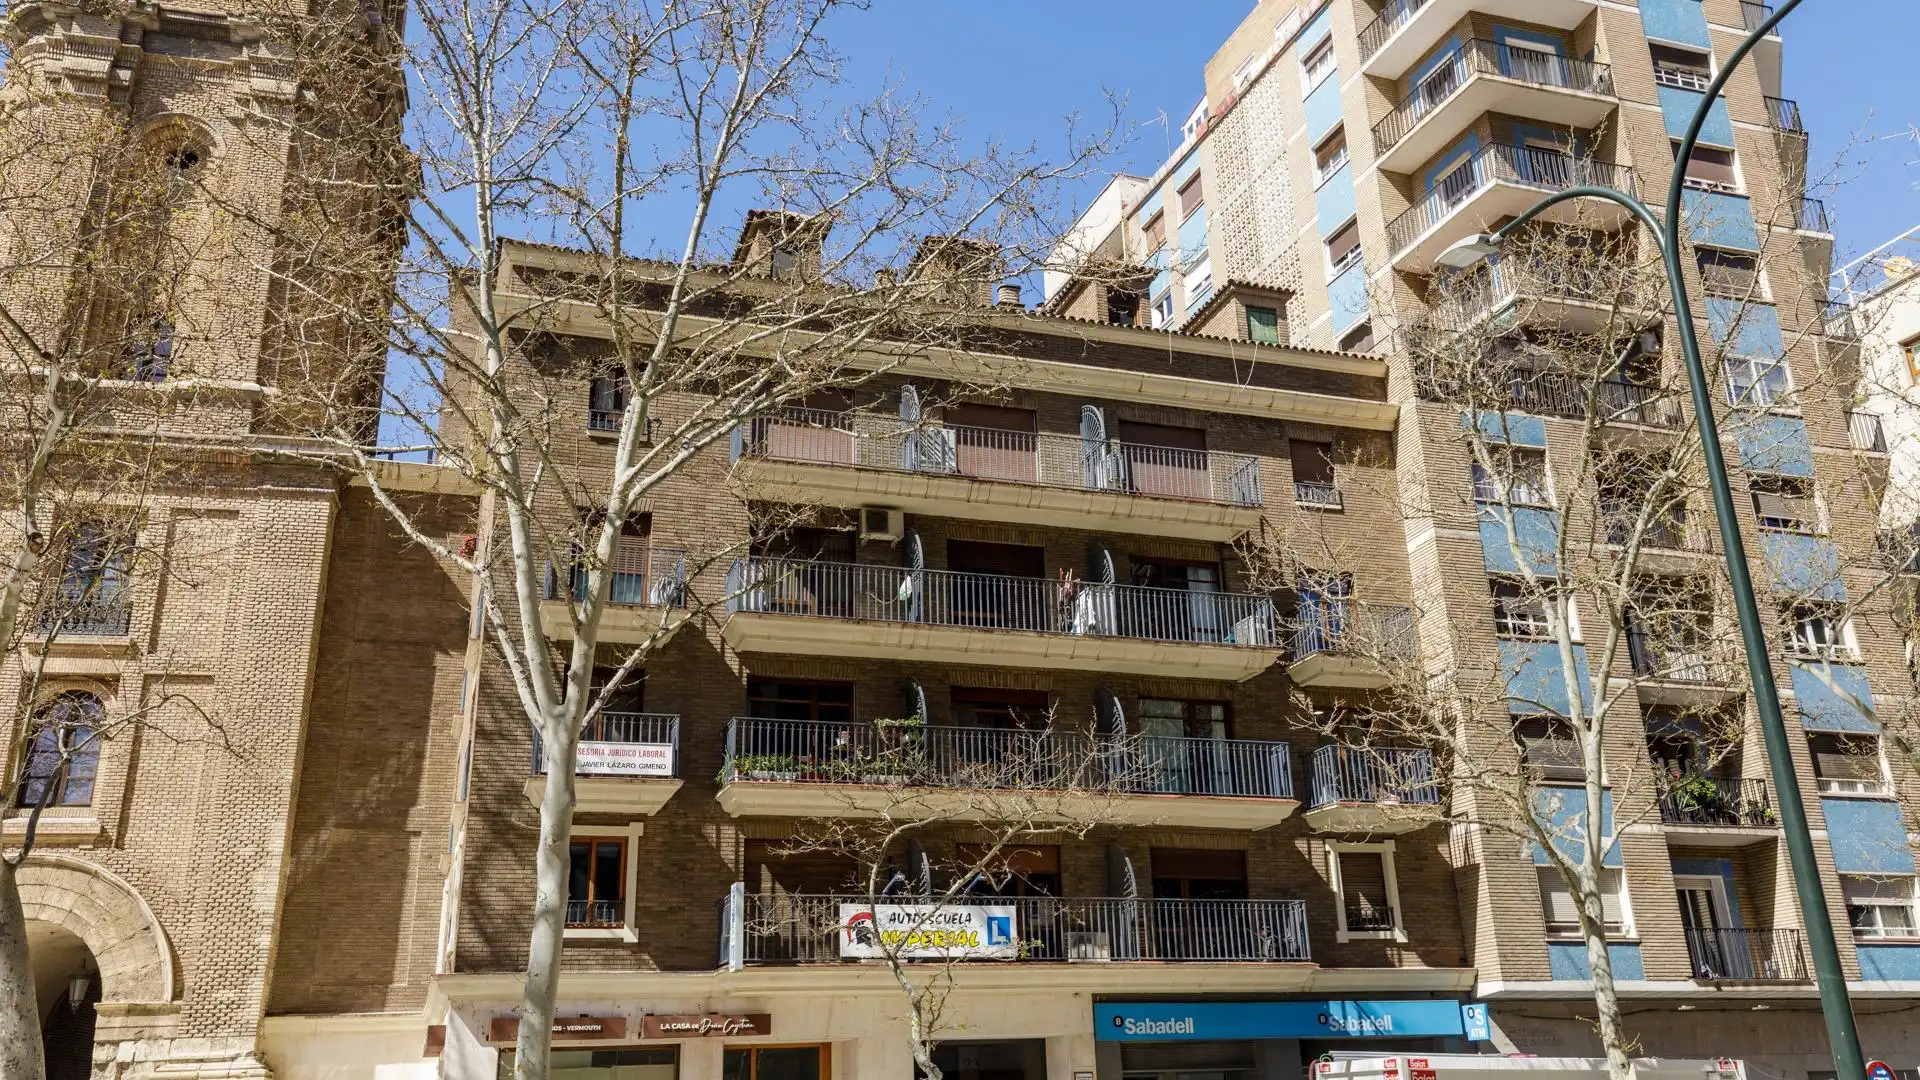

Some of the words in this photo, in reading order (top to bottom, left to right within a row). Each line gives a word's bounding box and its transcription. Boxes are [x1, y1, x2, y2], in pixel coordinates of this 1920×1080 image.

[577, 747, 605, 756] SESORÍA
[607, 748, 636, 757] JURÍDICO
[638, 750, 666, 758] LABORAL
[607, 760, 636, 769] LÁZARO
[881, 929, 980, 949] IMPERIAL
[992, 920, 1008, 944] L
[1125, 1017, 1194, 1035] Sabadell
[1329, 1014, 1392, 1032] Sabadell
[1474, 1009, 1484, 1026] S
[1471, 1028, 1486, 1038] ATM
